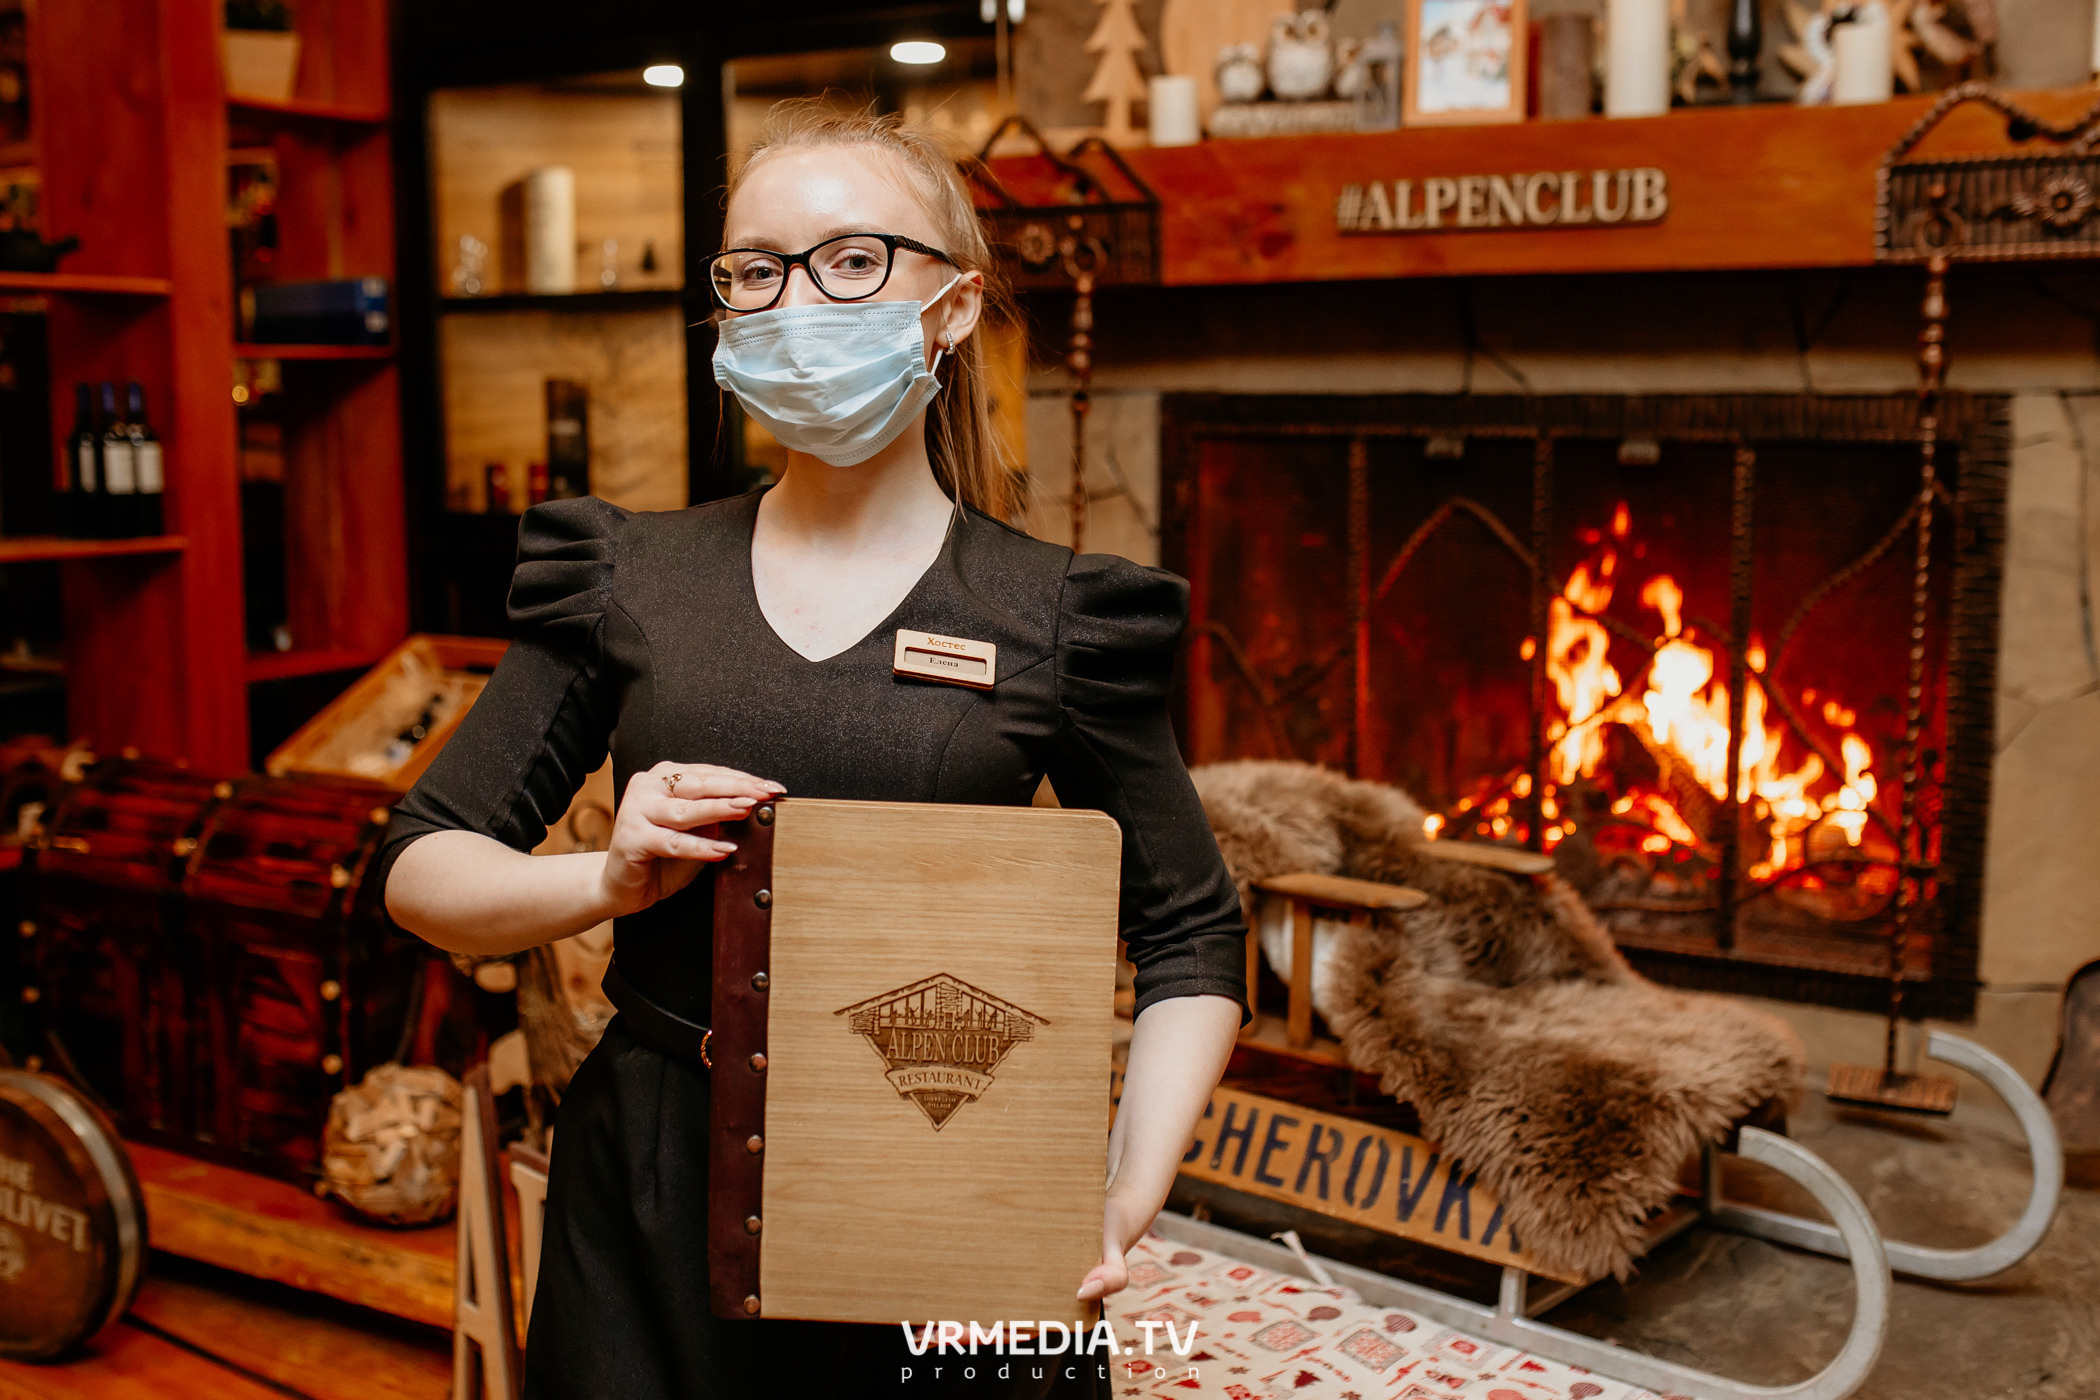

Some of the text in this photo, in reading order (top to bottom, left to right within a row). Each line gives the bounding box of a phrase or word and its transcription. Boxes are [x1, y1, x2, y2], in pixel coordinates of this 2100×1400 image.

[1336, 167, 1669, 231] #ALPENCLUB
[927, 637, 967, 651] Хостес
[929, 657, 959, 668] Елена
[886, 1027, 1000, 1064] ALPEN CLUB
[898, 1071, 983, 1090] RESTAURANT
